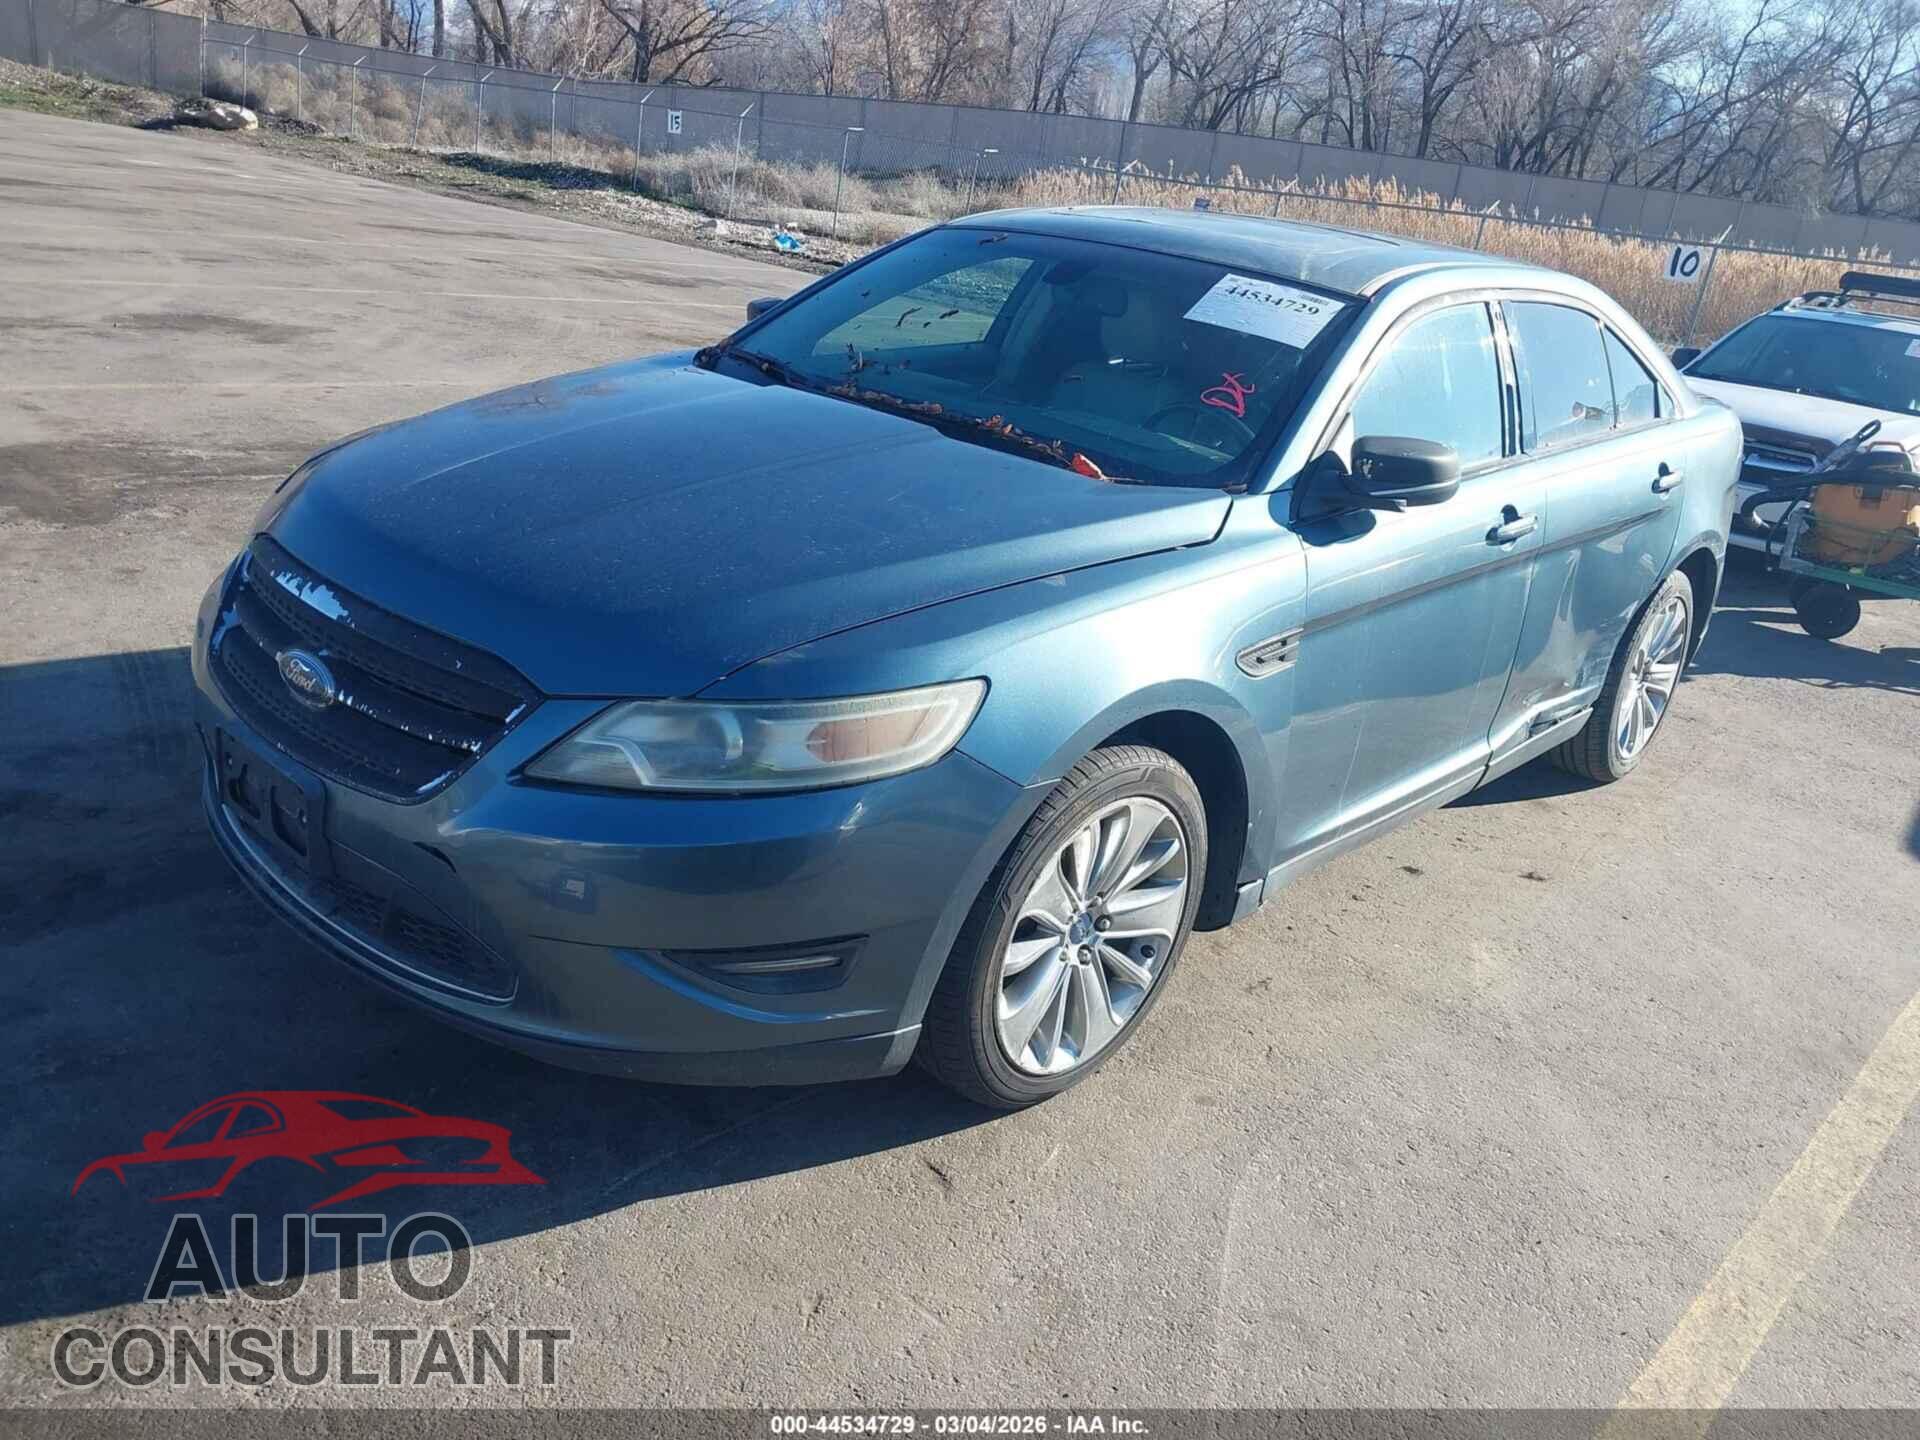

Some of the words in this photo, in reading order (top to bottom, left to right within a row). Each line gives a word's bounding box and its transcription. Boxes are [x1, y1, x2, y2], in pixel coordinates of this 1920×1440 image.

[670, 114, 681, 131] 15
[1670, 246, 1700, 277] 10
[1224, 286, 1320, 316] 44534729
[287, 658, 317, 691] Ford
